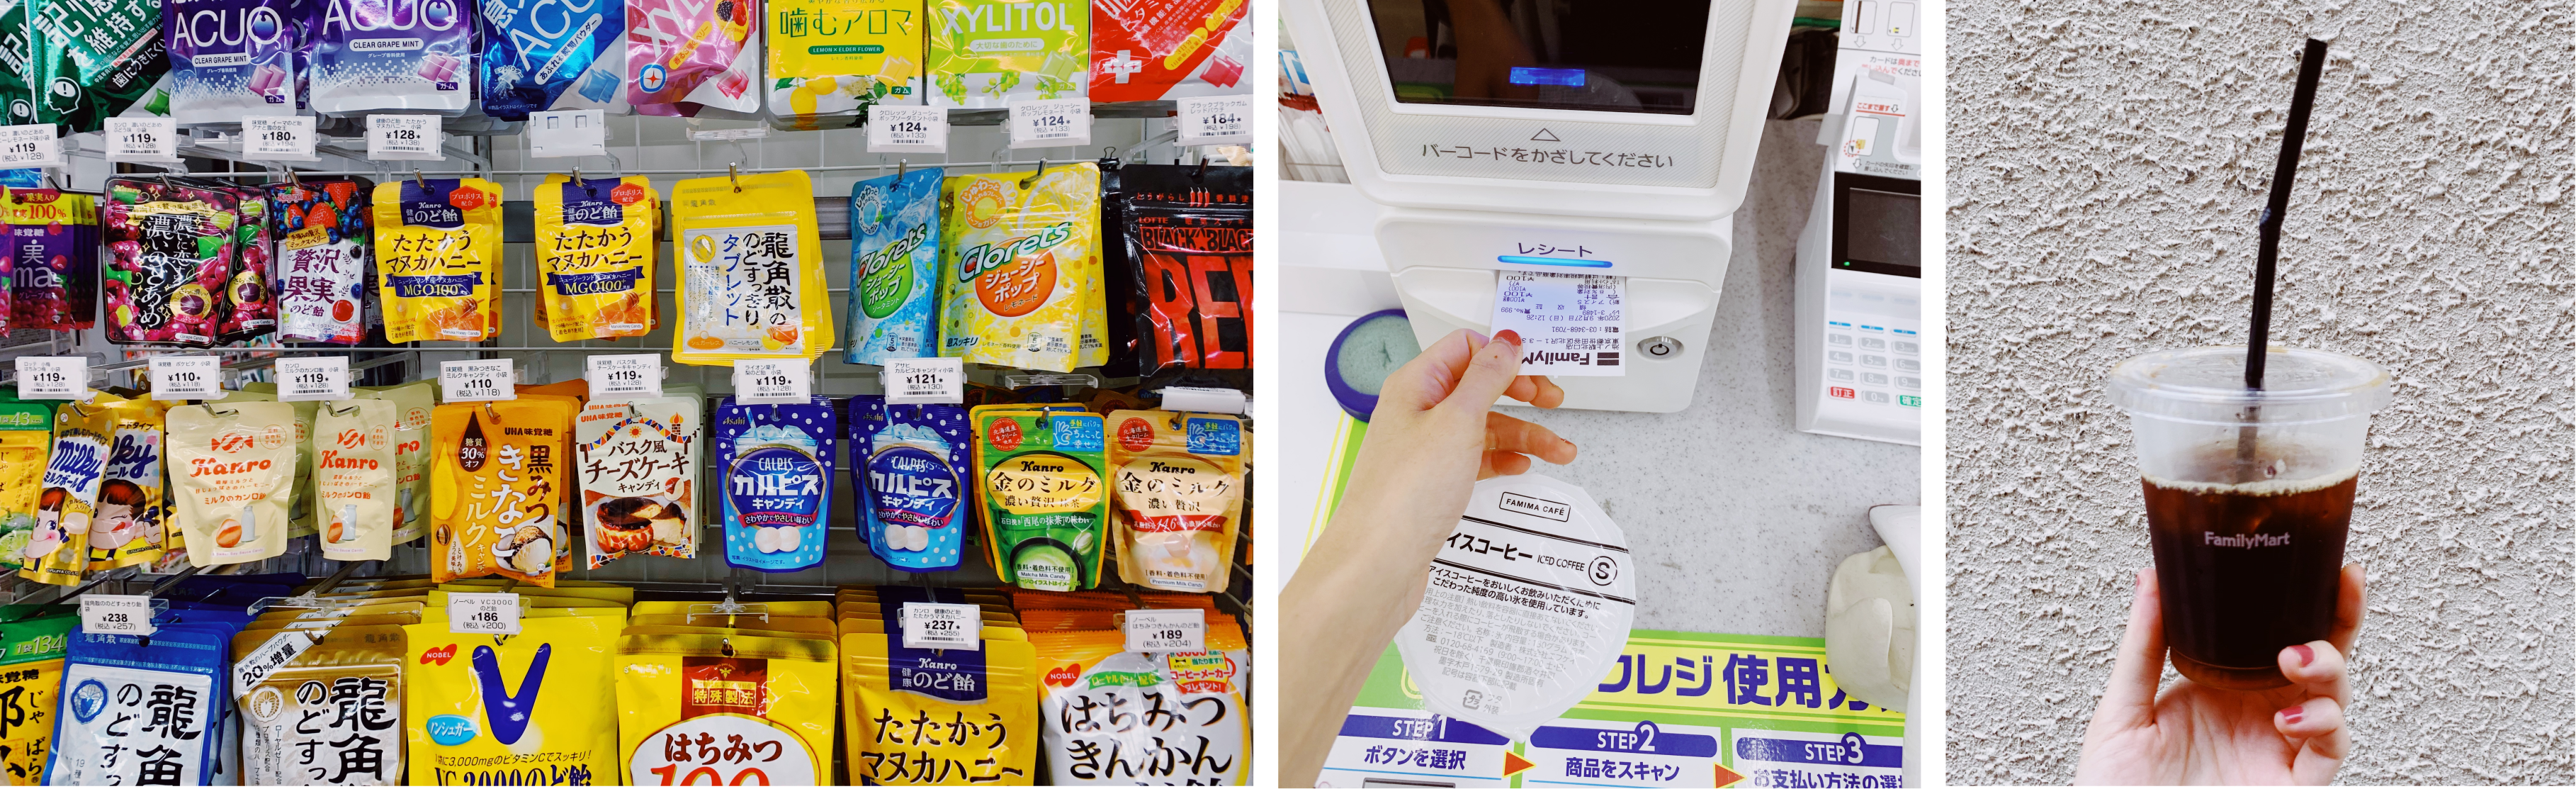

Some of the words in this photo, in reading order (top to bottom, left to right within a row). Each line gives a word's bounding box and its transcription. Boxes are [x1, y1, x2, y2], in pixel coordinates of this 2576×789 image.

[322, 0, 457, 35] ACUO
[780, 8, 912, 38] 噛むアロマ
[942, 2, 1074, 35] XYLITOL
[172, 6, 283, 50] ACUO
[1870, 56, 1921, 67] カードは奥まで
[1021, 108, 1066, 117] ポップレモネード
[9, 142, 35, 153] ¥119
[1422, 143, 1673, 169] バーコードをかざしてください
[414, 207, 458, 223] のど飴
[576, 205, 618, 220] のど飴
[14, 228, 44, 236] 味覚糖
[394, 230, 471, 252] たたかう
[555, 227, 633, 251] たたかう
[857, 224, 925, 285] Clorets
[959, 221, 1070, 282] Clorets
[1518, 242, 1593, 257] レシート
[291, 249, 340, 274] 贅沢
[386, 254, 480, 274] マヌカハニー
[547, 251, 643, 272] マヌカハニー
[723, 234, 742, 327] タブレット
[761, 232, 796, 325] 龍角散の
[985, 259, 1046, 290] ジューシー
[285, 275, 334, 304] 果実
[994, 272, 1041, 303] ポップ
[290, 305, 324, 318] のど飴
[946, 337, 978, 347] 息スッキリ
[1521, 350, 1590, 366] FamilyM
[465, 379, 492, 388] ¥110
[1831, 387, 1853, 398] 訂正
[580, 412, 623, 423] UHA味覚糖
[465, 437, 482, 446] 糖質
[504, 427, 553, 437] UHA味覚糖
[608, 439, 667, 457] バスク風
[190, 457, 271, 478] Kanro
[320, 449, 378, 471] Kanro
[585, 452, 689, 484] チーズケーキ
[1020, 460, 1064, 472] Kanro
[1149, 461, 1195, 474] Kanro
[526, 444, 553, 524] 黒みつ
[618, 479, 660, 493] キャンディ
[733, 474, 818, 496] カルピス
[869, 469, 953, 499] カルピス
[992, 471, 1096, 493] 金のミルク
[1121, 471, 1229, 497] 金のミルク
[752, 498, 804, 510] キャンディ
[1005, 497, 1056, 508] 濃い贅沢
[1148, 498, 1201, 512] 濃い贅沢
[1506, 498, 1540, 512] FAMIMA
[1542, 506, 1565, 517] CAFÉ
[745, 513, 813, 525] さわやかでやさしい味わい
[2204, 530, 2290, 550] FamilyMart
[1537, 554, 1555, 566] ICED
[1556, 559, 1586, 571] COFFEE
[1428, 565, 1601, 610] アイスコーヒーをおいしくお飲みいただくために
[1433, 576, 1590, 620] こだわった純度の高い氷を使用しています。
[103, 613, 128, 622] ¥238
[471, 612, 498, 621] ¥186
[1152, 630, 1182, 639] ¥189
[1440, 637, 1494, 656] 0120-68-4169
[918, 658, 957, 670] Kanro
[913, 673, 976, 692] のど飴
[1170, 669, 1231, 681] コーヒーメーカー
[1441, 666, 1517, 691] 記号は容器下部に記載
[472, 642, 551, 745] V
[694, 688, 755, 705] 特殊製法
[1060, 691, 1227, 734] はちみつ
[429, 722, 476, 737] ノンシュガー
[874, 707, 1008, 749] たたかう
[665, 732, 783, 765] はちみつ
[1066, 735, 1233, 780] きんかん
[1364, 745, 1467, 771] ボタンを選択
[861, 751, 1024, 784] マヌカハニー
[1566, 757, 1680, 783] 商品をスキャン
